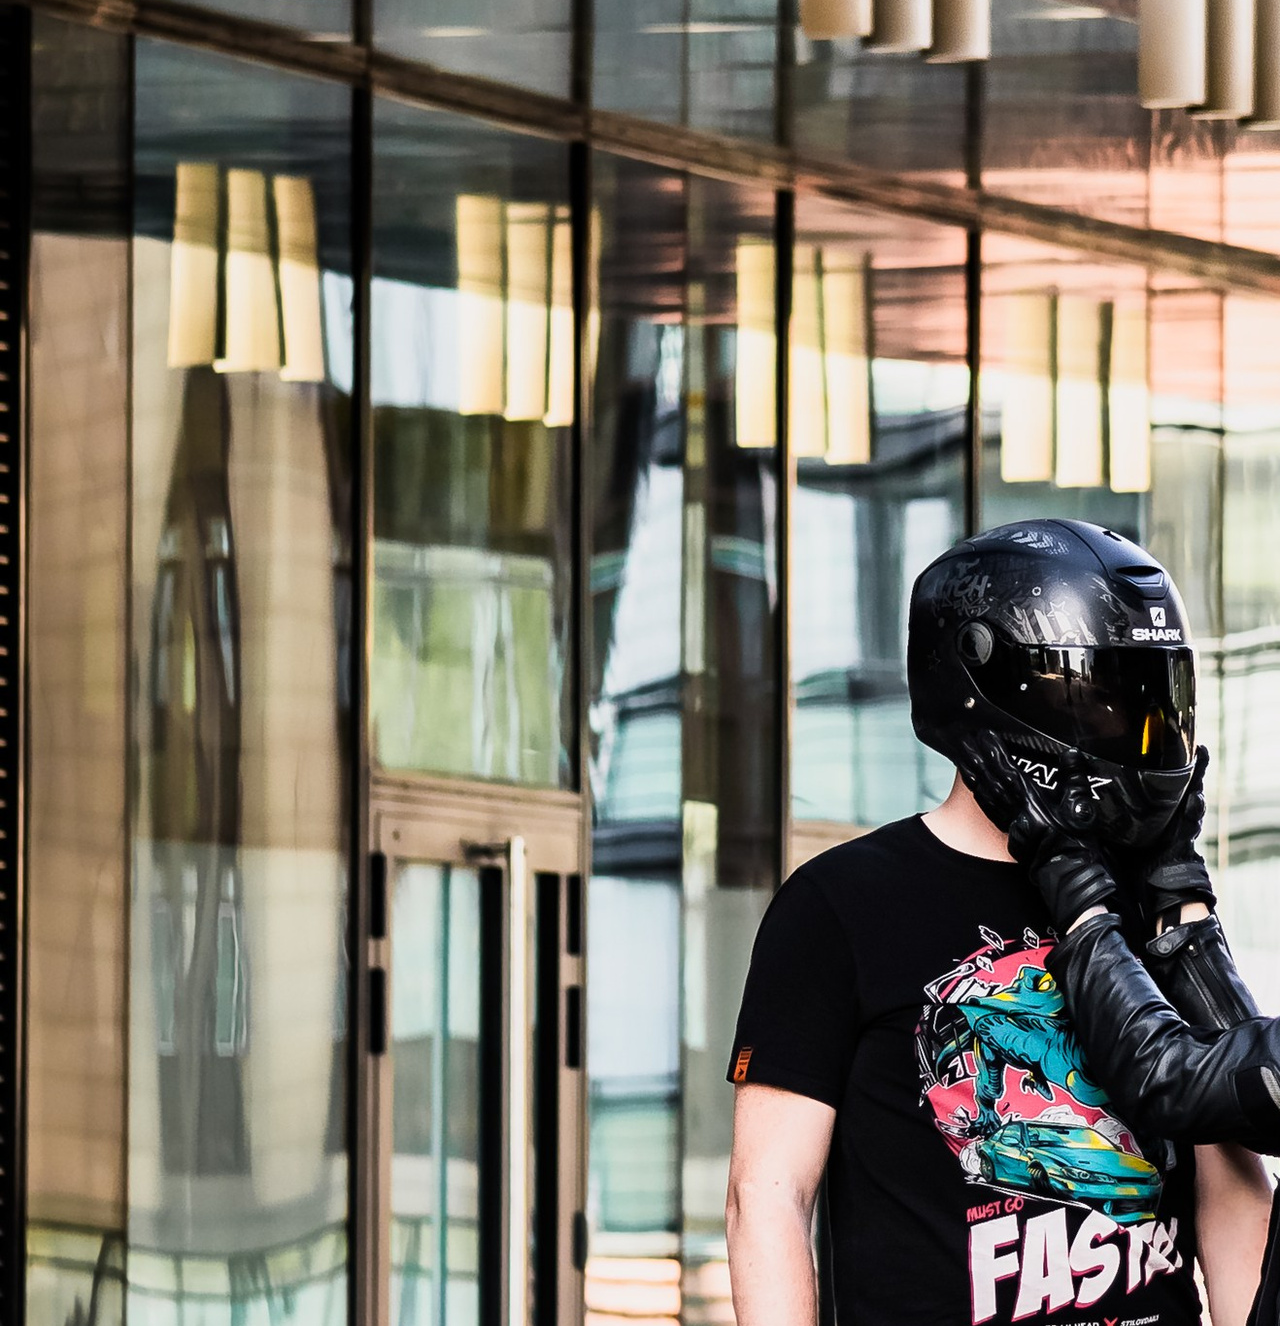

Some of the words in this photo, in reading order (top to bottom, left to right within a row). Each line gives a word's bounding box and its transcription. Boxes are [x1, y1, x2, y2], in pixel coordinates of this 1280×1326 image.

[1131, 627, 1183, 642] SHARK
[965, 1200, 1002, 1223] MUST
[1003, 1194, 1026, 1214] GO
